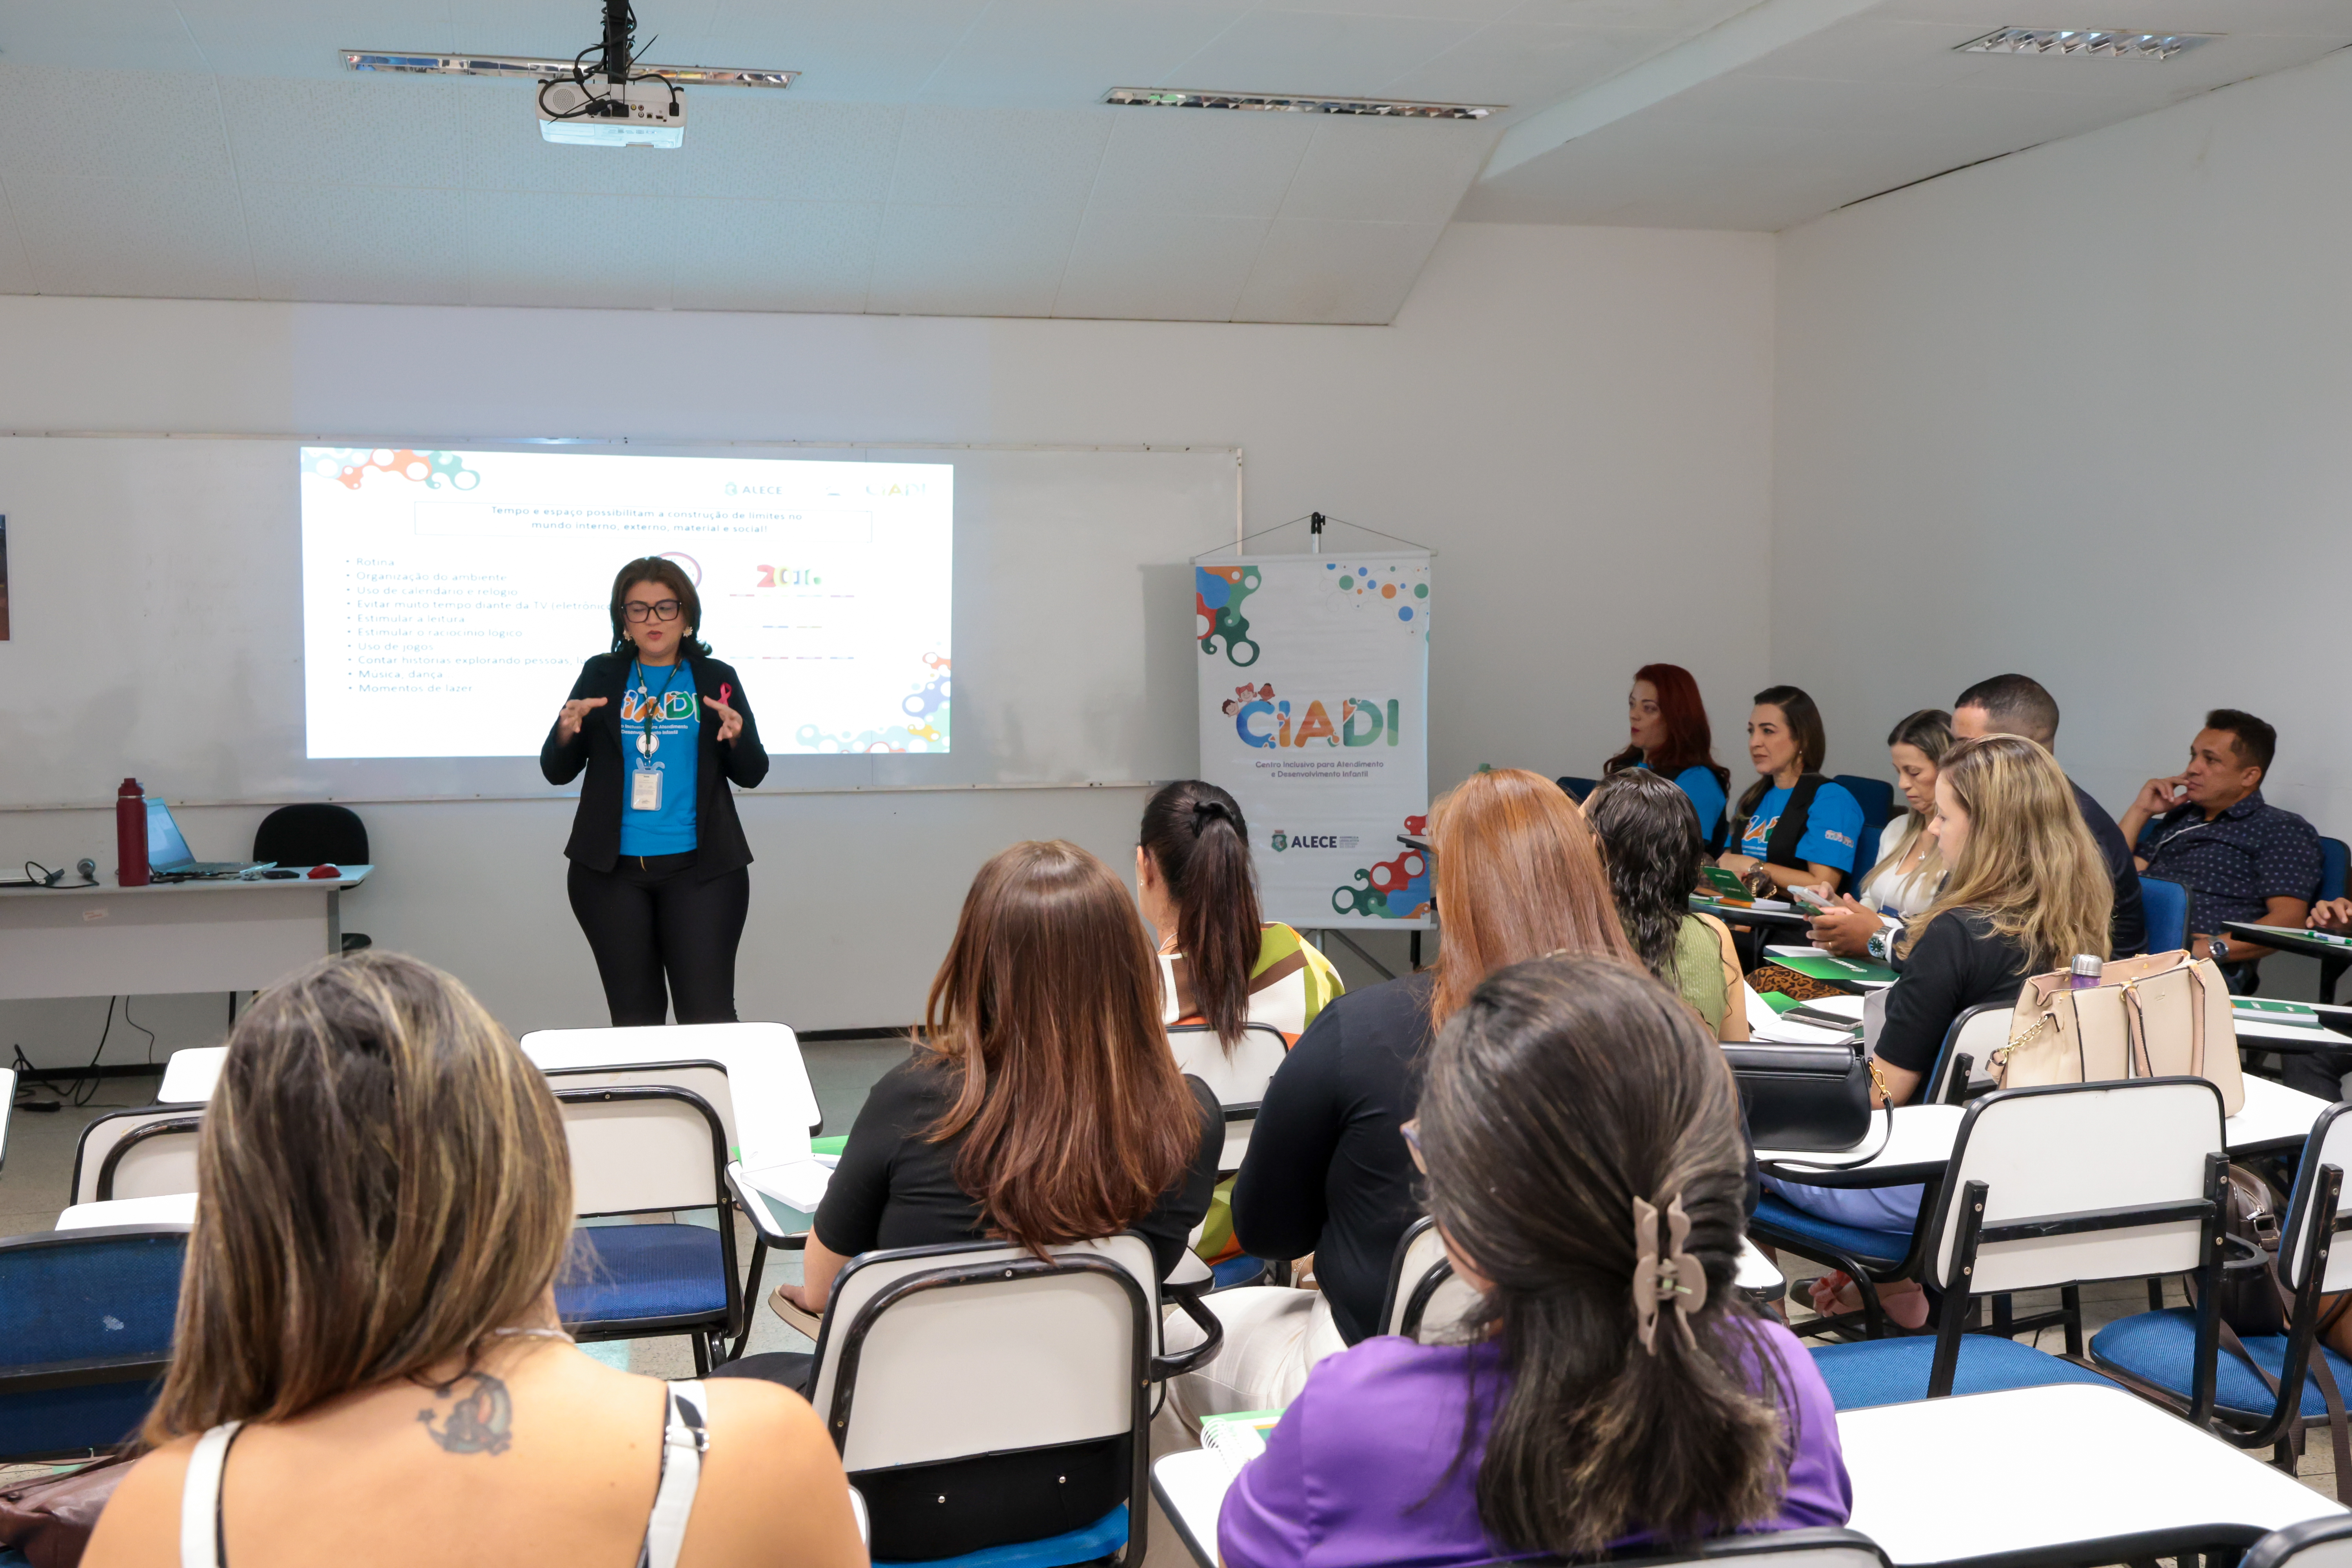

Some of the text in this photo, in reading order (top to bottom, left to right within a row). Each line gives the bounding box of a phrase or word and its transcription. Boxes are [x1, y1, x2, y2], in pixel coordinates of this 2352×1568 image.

[742, 486, 782, 494] ALECE
[492, 506, 529, 516] Tempo
[587, 509, 654, 517] possibilitam
[668, 511, 728, 520] construção
[576, 522, 619, 531] interno,
[357, 572, 429, 582] Organização
[358, 600, 390, 608] Evitar
[358, 614, 413, 622] Estimular
[358, 656, 397, 664] Contar
[456, 656, 520, 665] explorando
[359, 670, 403, 679] Música,
[1236, 699, 1399, 748] CIADI
[1291, 836, 1337, 848] ALECE
